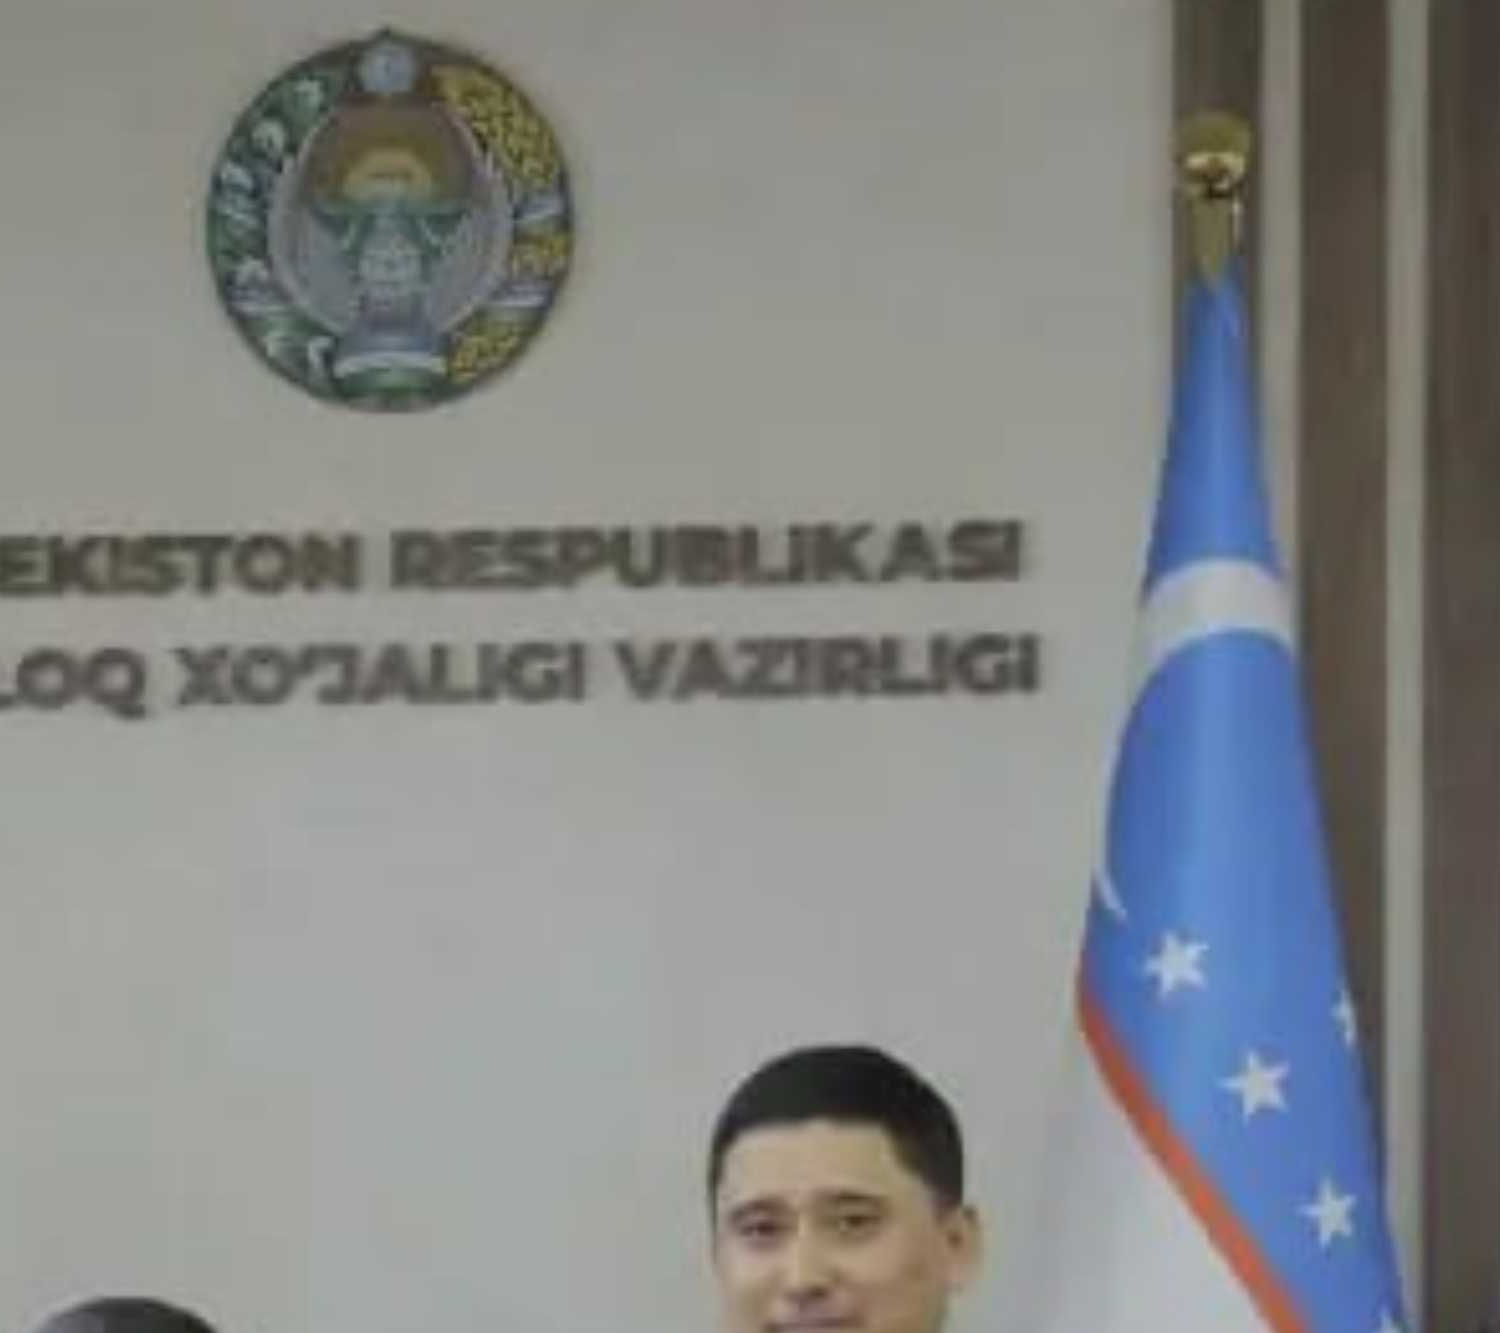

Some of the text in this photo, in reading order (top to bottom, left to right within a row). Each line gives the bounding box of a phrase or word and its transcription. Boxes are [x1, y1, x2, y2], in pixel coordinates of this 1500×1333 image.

[389, 519, 1025, 593] RESPUBLIKASI
[170, 642, 588, 706] XO'JALIGI
[611, 633, 1042, 704] VAZIRLIGI
